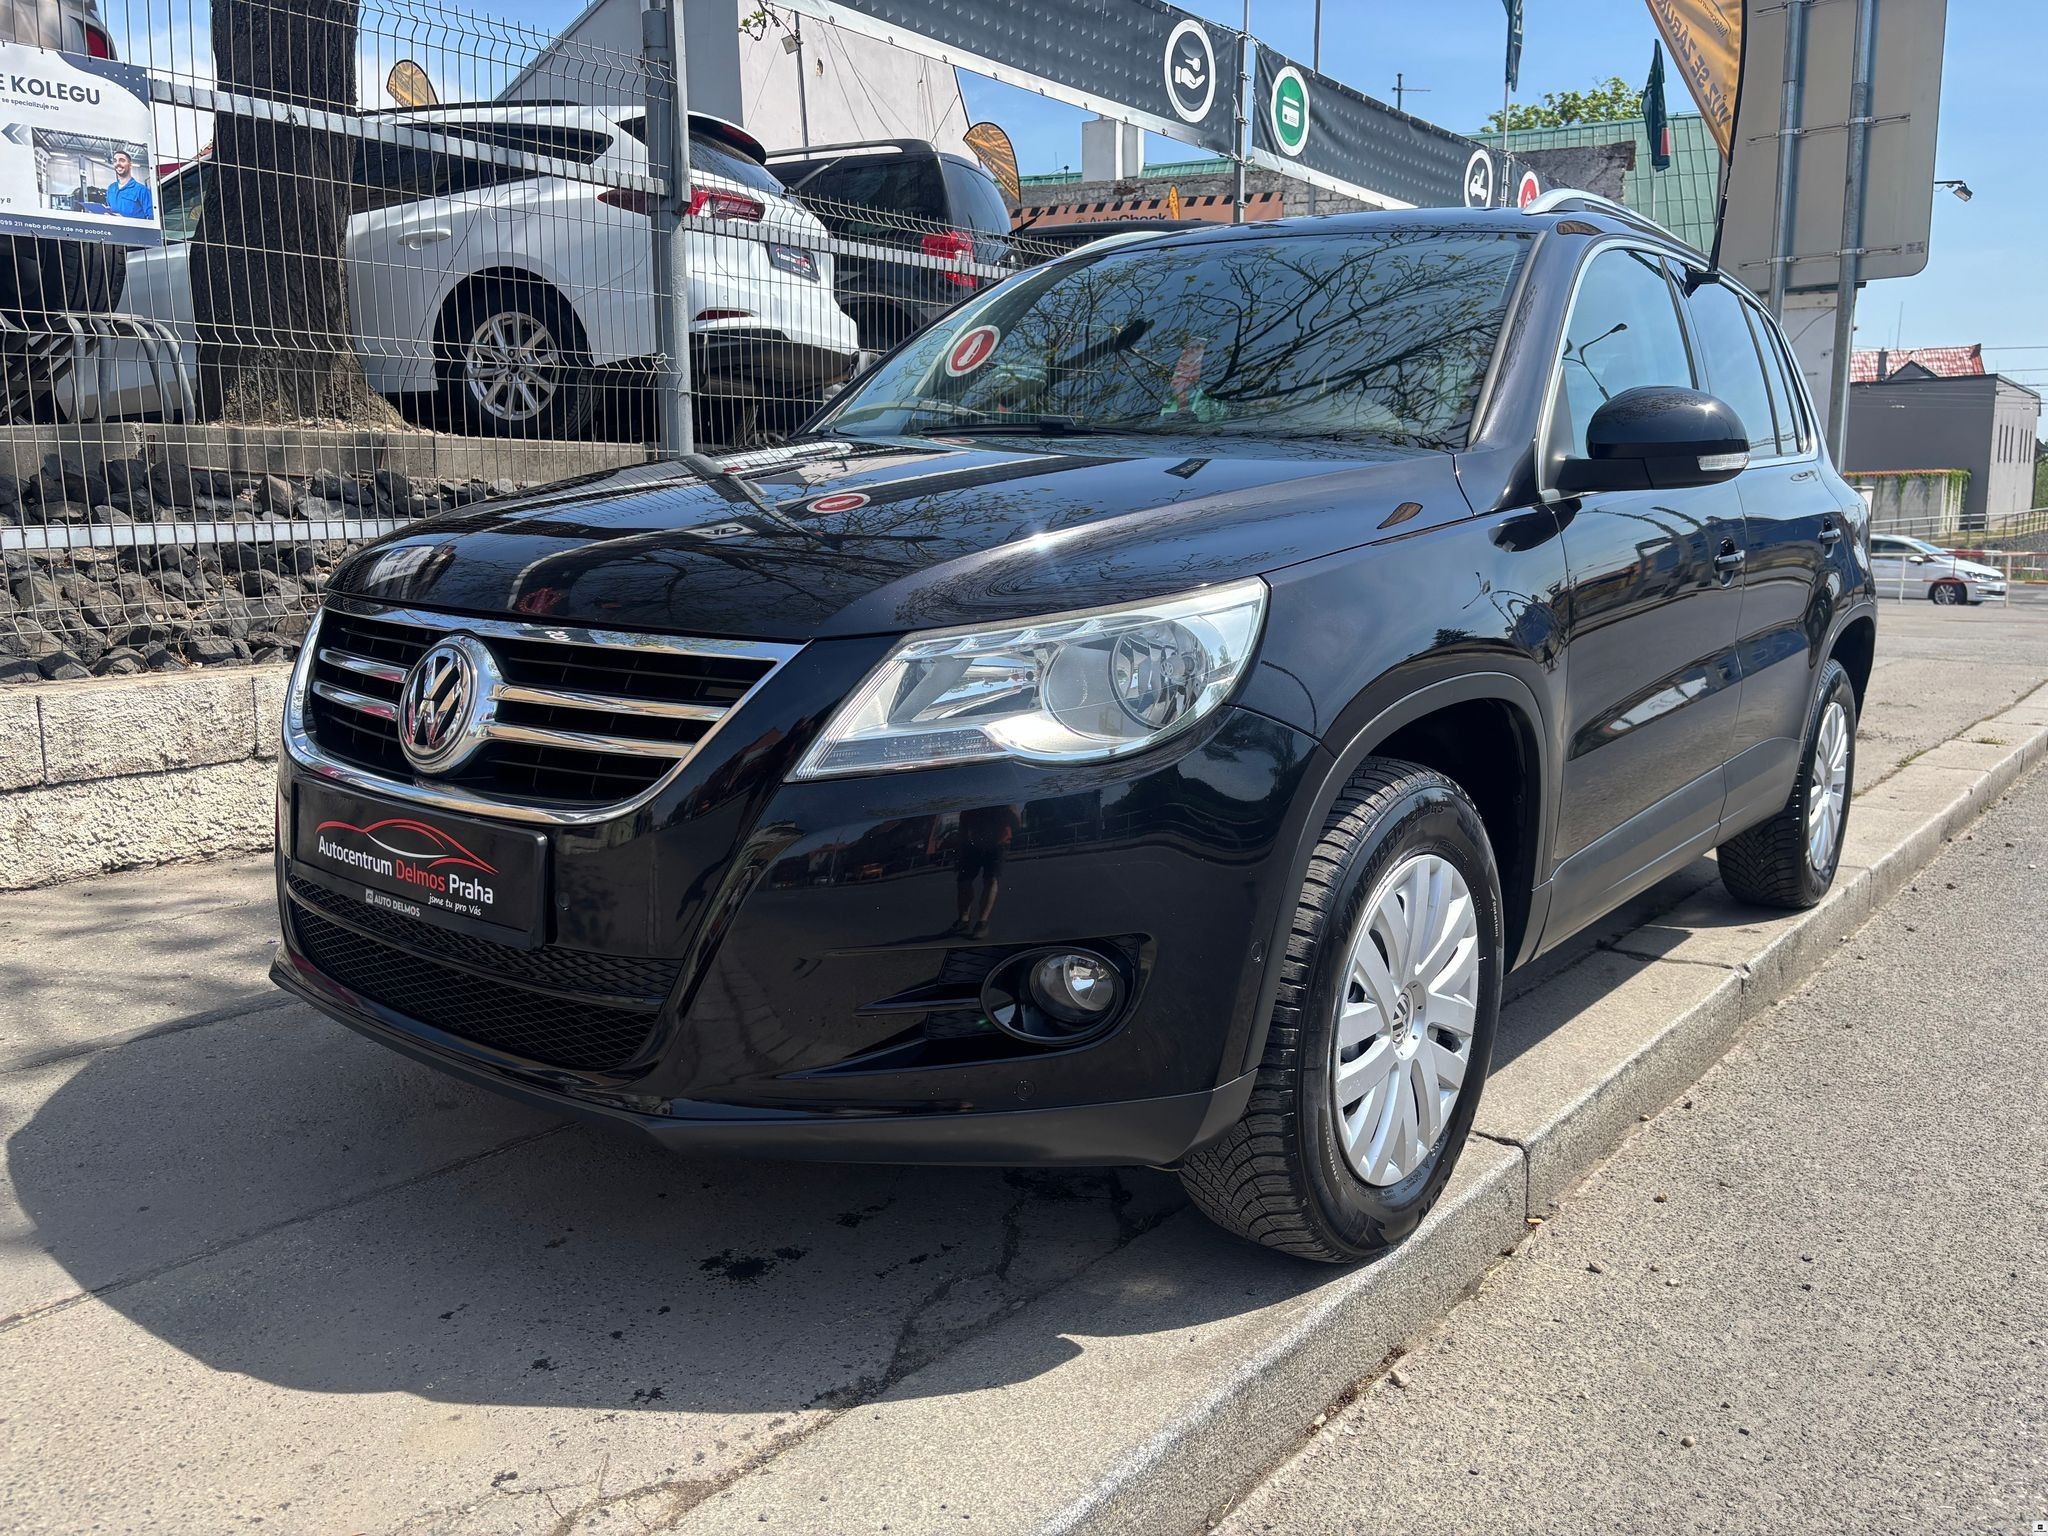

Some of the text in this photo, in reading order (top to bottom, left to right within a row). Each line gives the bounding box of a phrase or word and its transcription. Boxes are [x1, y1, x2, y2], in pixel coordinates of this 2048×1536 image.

[11, 75, 100, 105] KOLEGU
[11, 99, 49, 110] specializuje
[318, 835, 494, 905] Autocentrum Delmos Praha
[374, 894, 420, 917] AUTO DELMOS
[428, 893, 482, 917] jsme tu pro Vás
